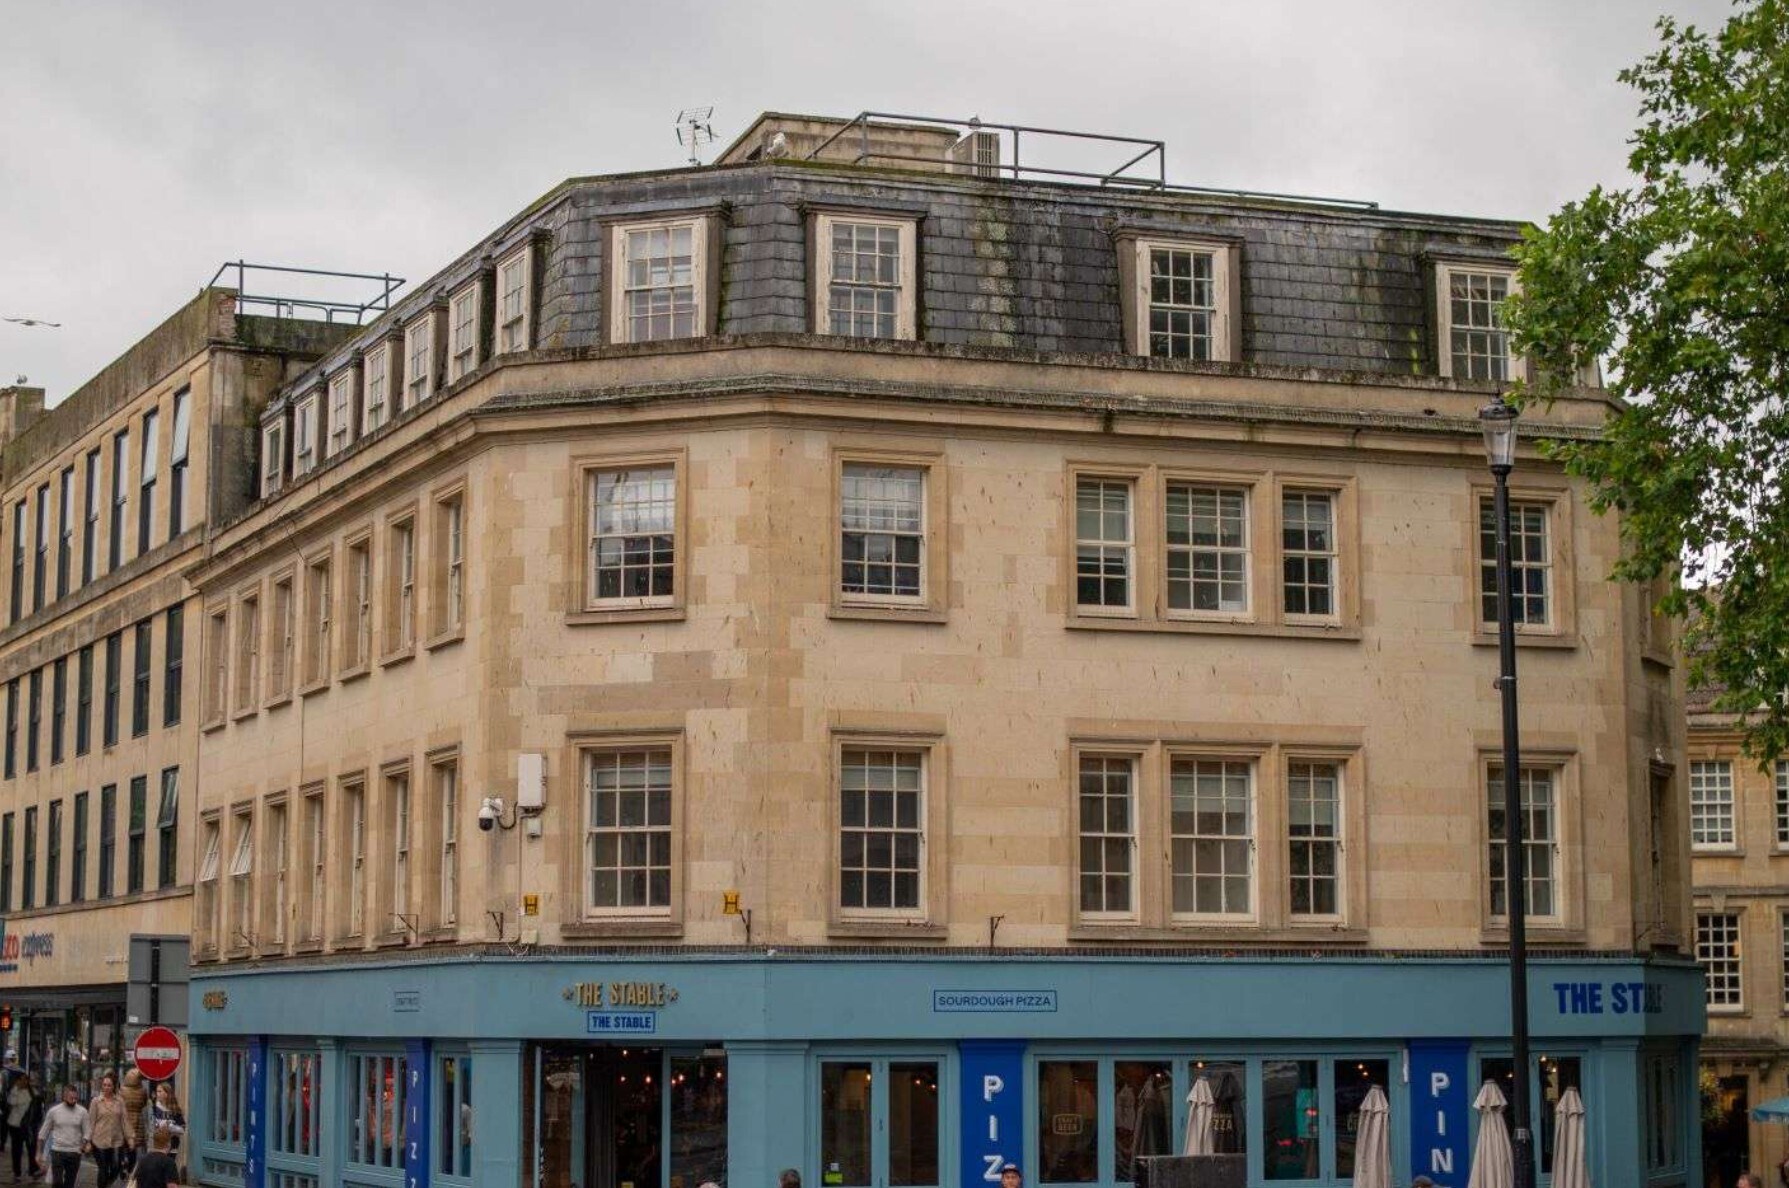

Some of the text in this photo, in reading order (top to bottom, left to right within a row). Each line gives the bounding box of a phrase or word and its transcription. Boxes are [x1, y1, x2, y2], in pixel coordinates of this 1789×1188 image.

[575, 982, 665, 1006] THE STABLE
[939, 996, 1051, 1006] SOURDOUGH PIZZA
[1553, 983, 1603, 1014] THE
[592, 1016, 651, 1028] THE STABLE
